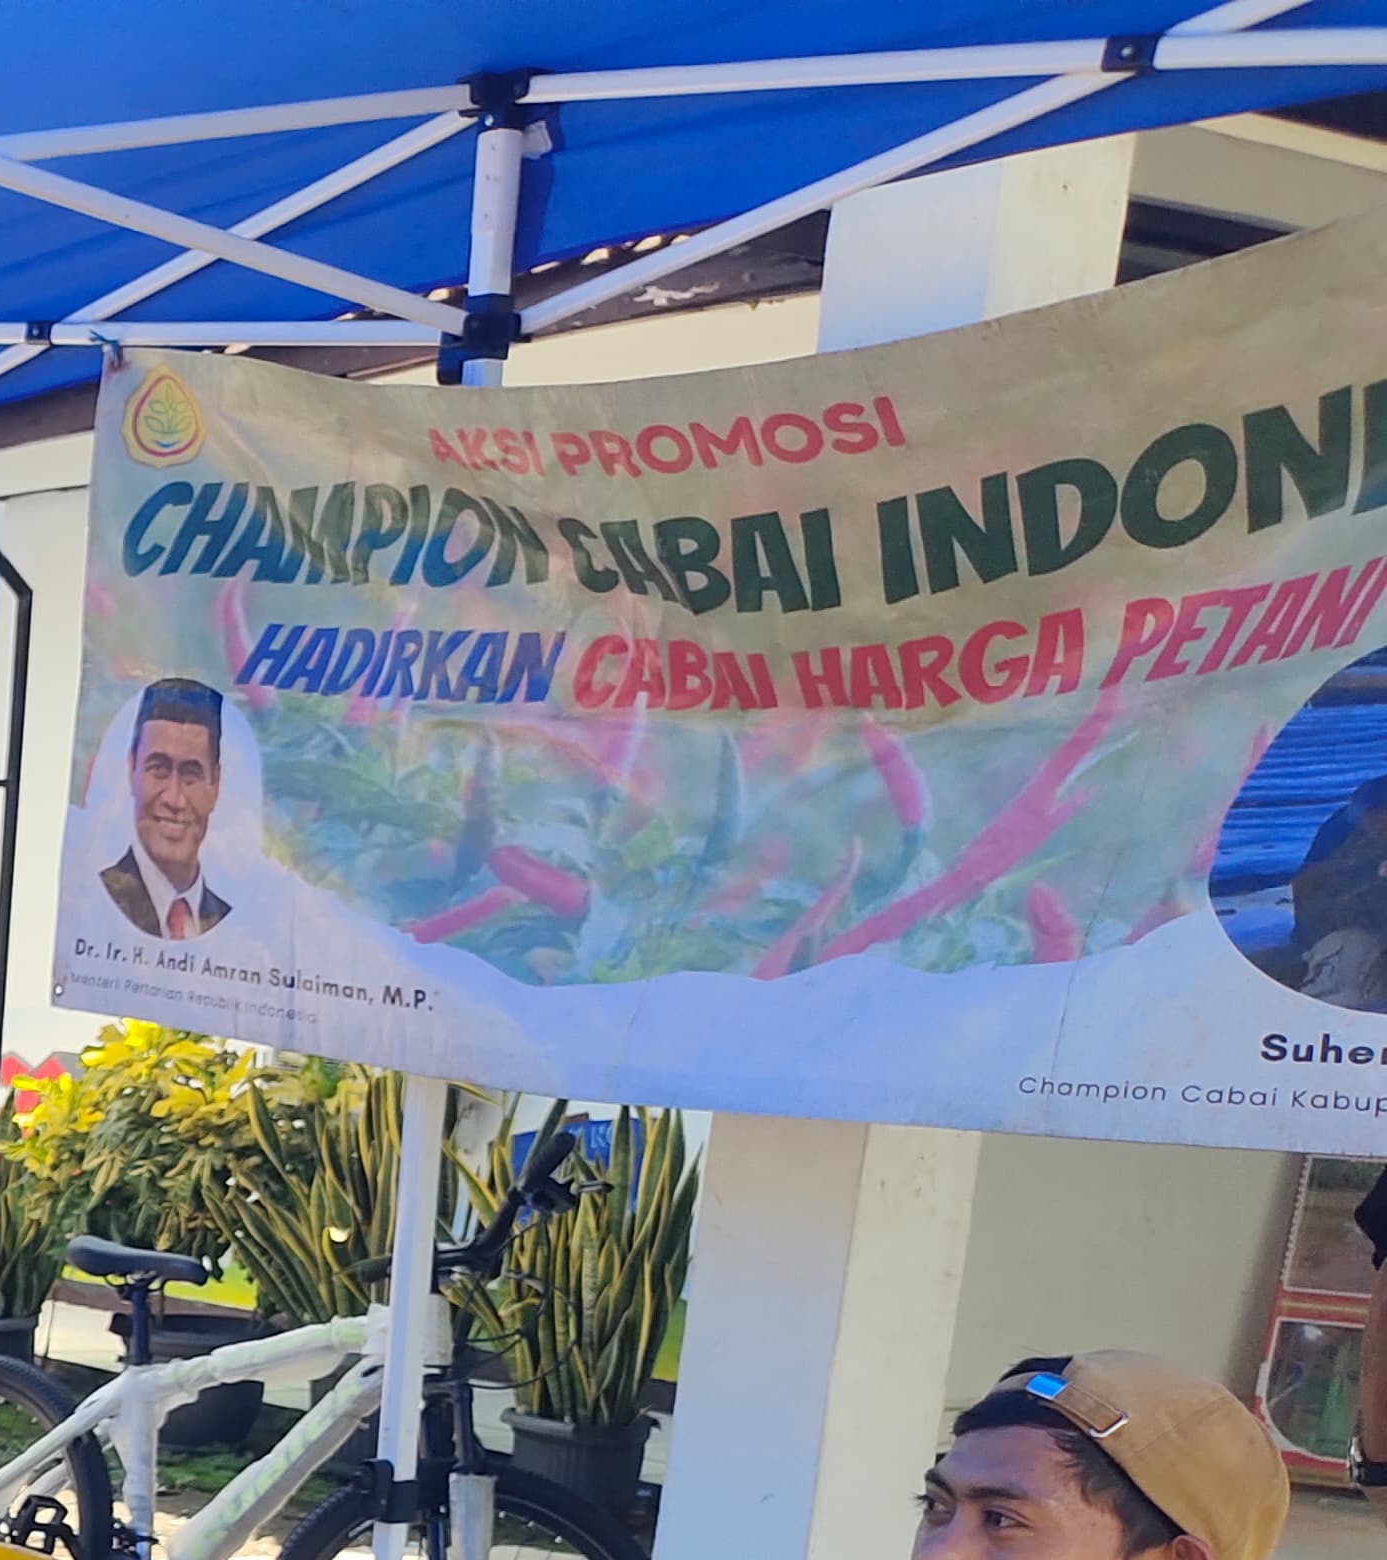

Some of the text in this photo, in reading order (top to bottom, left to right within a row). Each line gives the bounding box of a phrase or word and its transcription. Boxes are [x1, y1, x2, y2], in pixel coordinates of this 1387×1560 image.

[428, 395, 906, 478] AKSI PROMOSI
[122, 480, 549, 587] CHAMPION
[557, 507, 842, 615] CABAI
[235, 555, 1387, 711] HADIRKAN CABAI HARGA PETANI
[74, 937, 434, 1012] Dr. Ir. H. Andi Amran Sulaiman, M.P.
[123, 979, 183, 1001] Pertanian
[1018, 1076, 1167, 1104] Champion
[1180, 1083, 1278, 1108] Cabai
